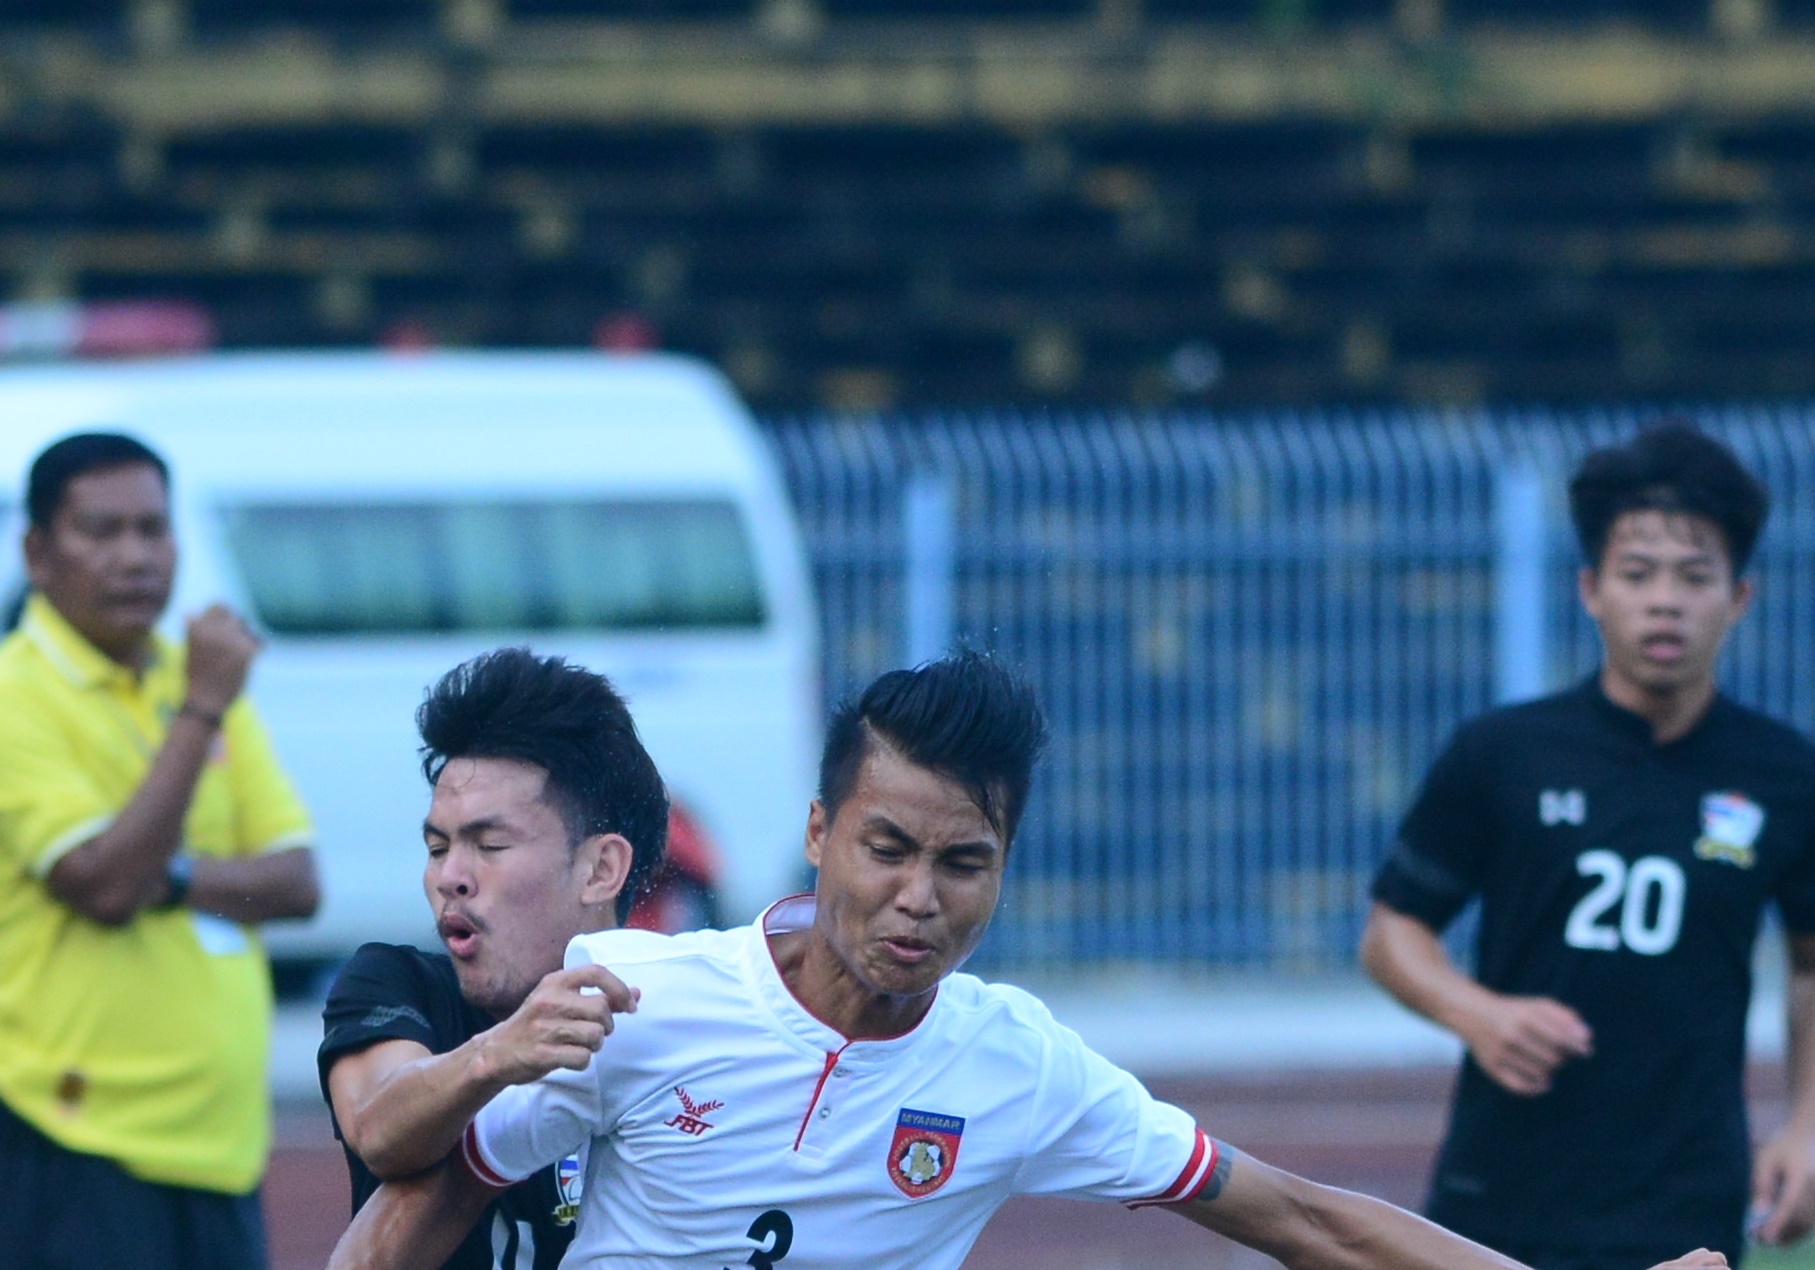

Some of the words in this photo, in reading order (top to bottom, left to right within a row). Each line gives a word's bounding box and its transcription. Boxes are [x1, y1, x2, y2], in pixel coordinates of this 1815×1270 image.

[1564, 849, 1687, 955] 20
[663, 1114, 714, 1136] FBT
[900, 1113, 961, 1129] MYANMAR
